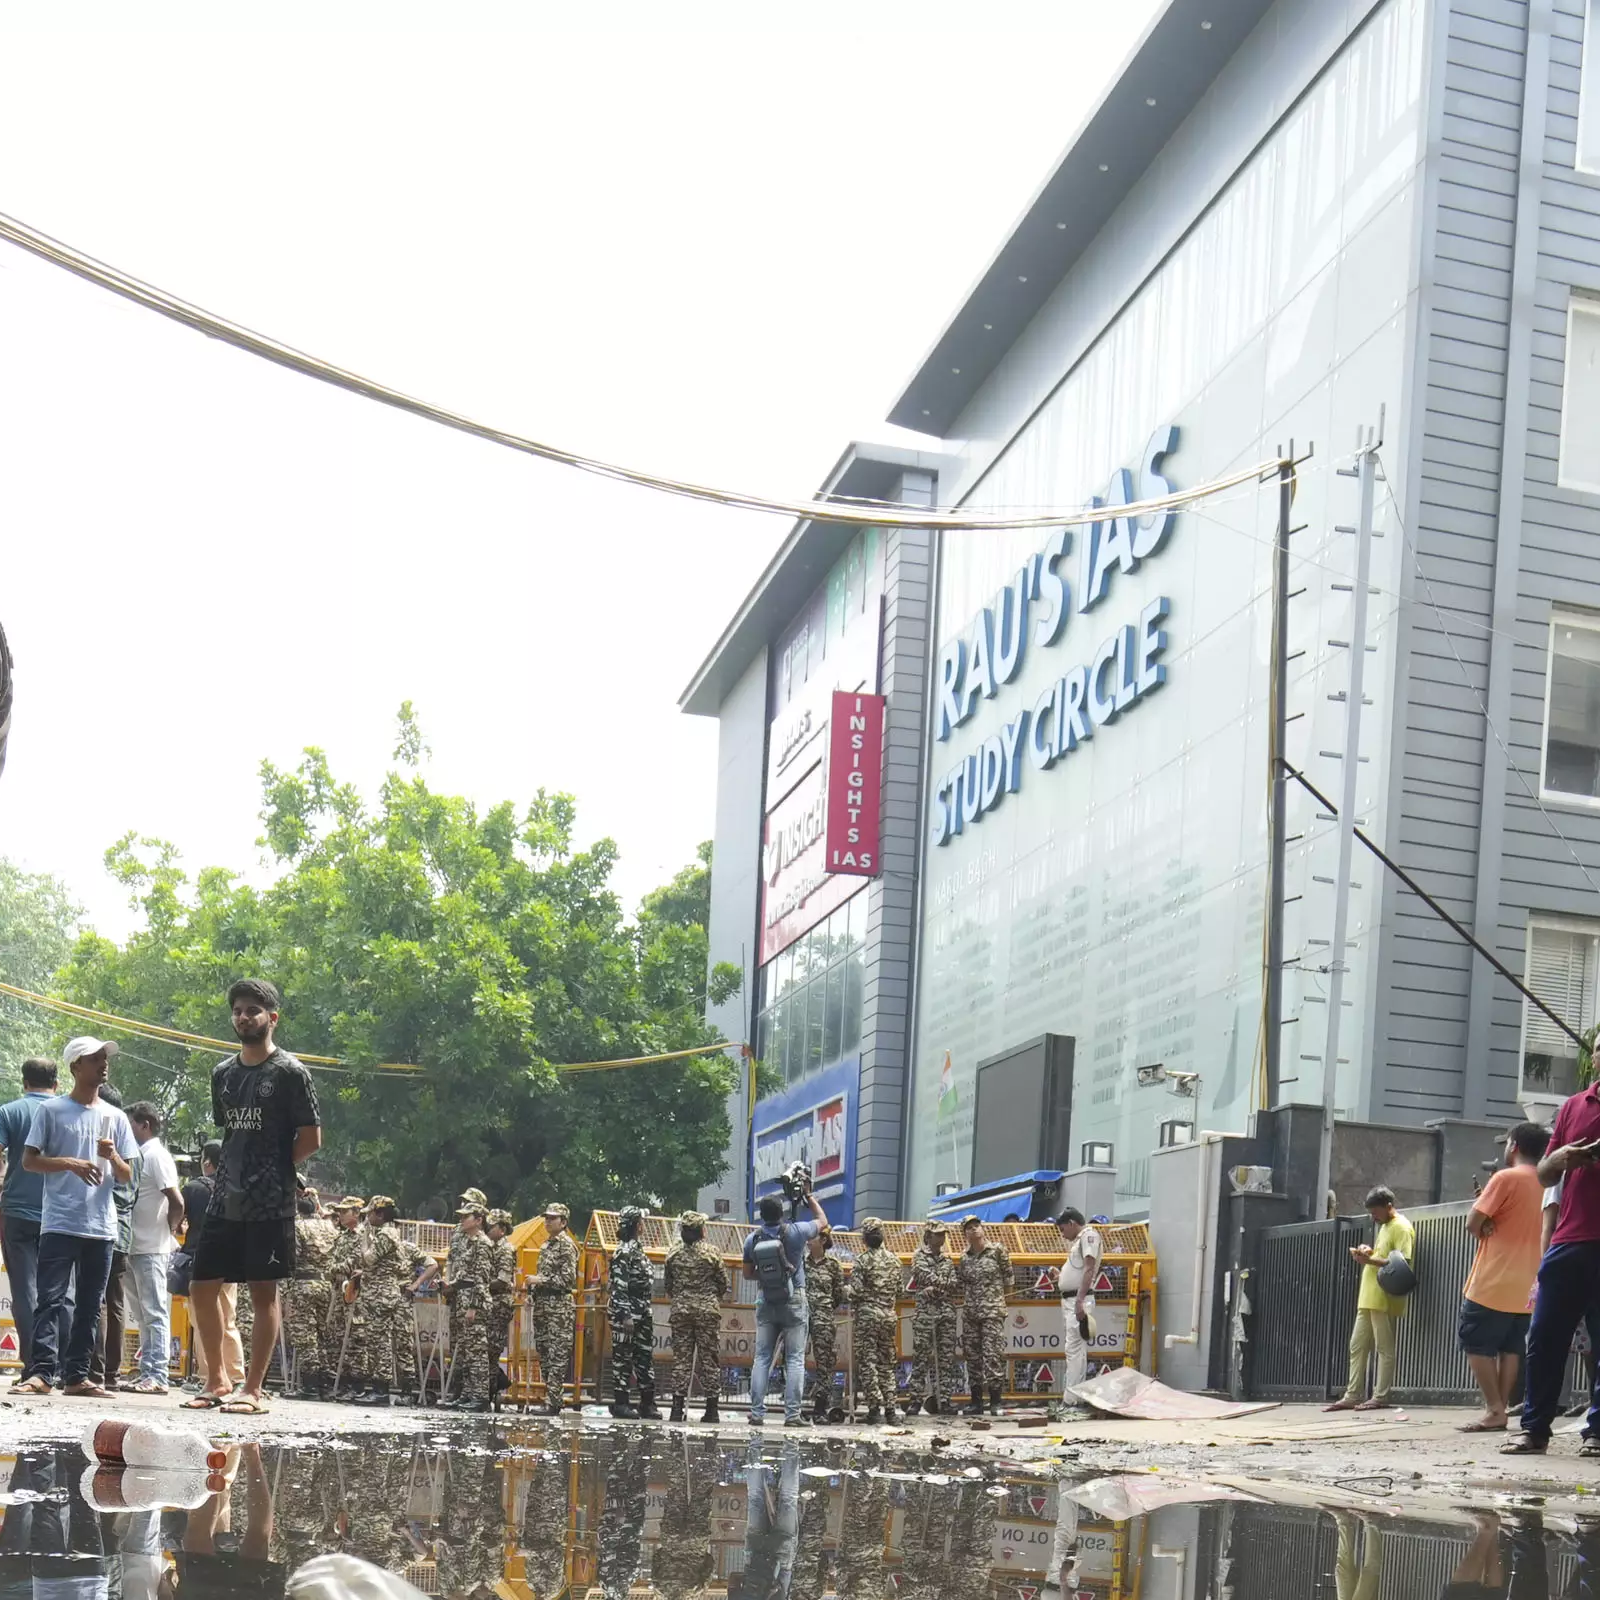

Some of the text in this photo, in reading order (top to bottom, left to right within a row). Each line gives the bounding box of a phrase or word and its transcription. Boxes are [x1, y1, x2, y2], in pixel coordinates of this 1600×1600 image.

[936, 424, 1180, 742] RAU'S IAS
[931, 709, 1031, 847] STUDY
[1028, 596, 1169, 771] CIRCLE
[847, 698, 866, 843] INSIGHTS
[781, 794, 825, 868] INSIGH
[833, 850, 872, 868] IAS
[726, 1336, 749, 1352] NO
[1013, 1334, 1035, 1348] NO
[1039, 1334, 1060, 1347] TO
